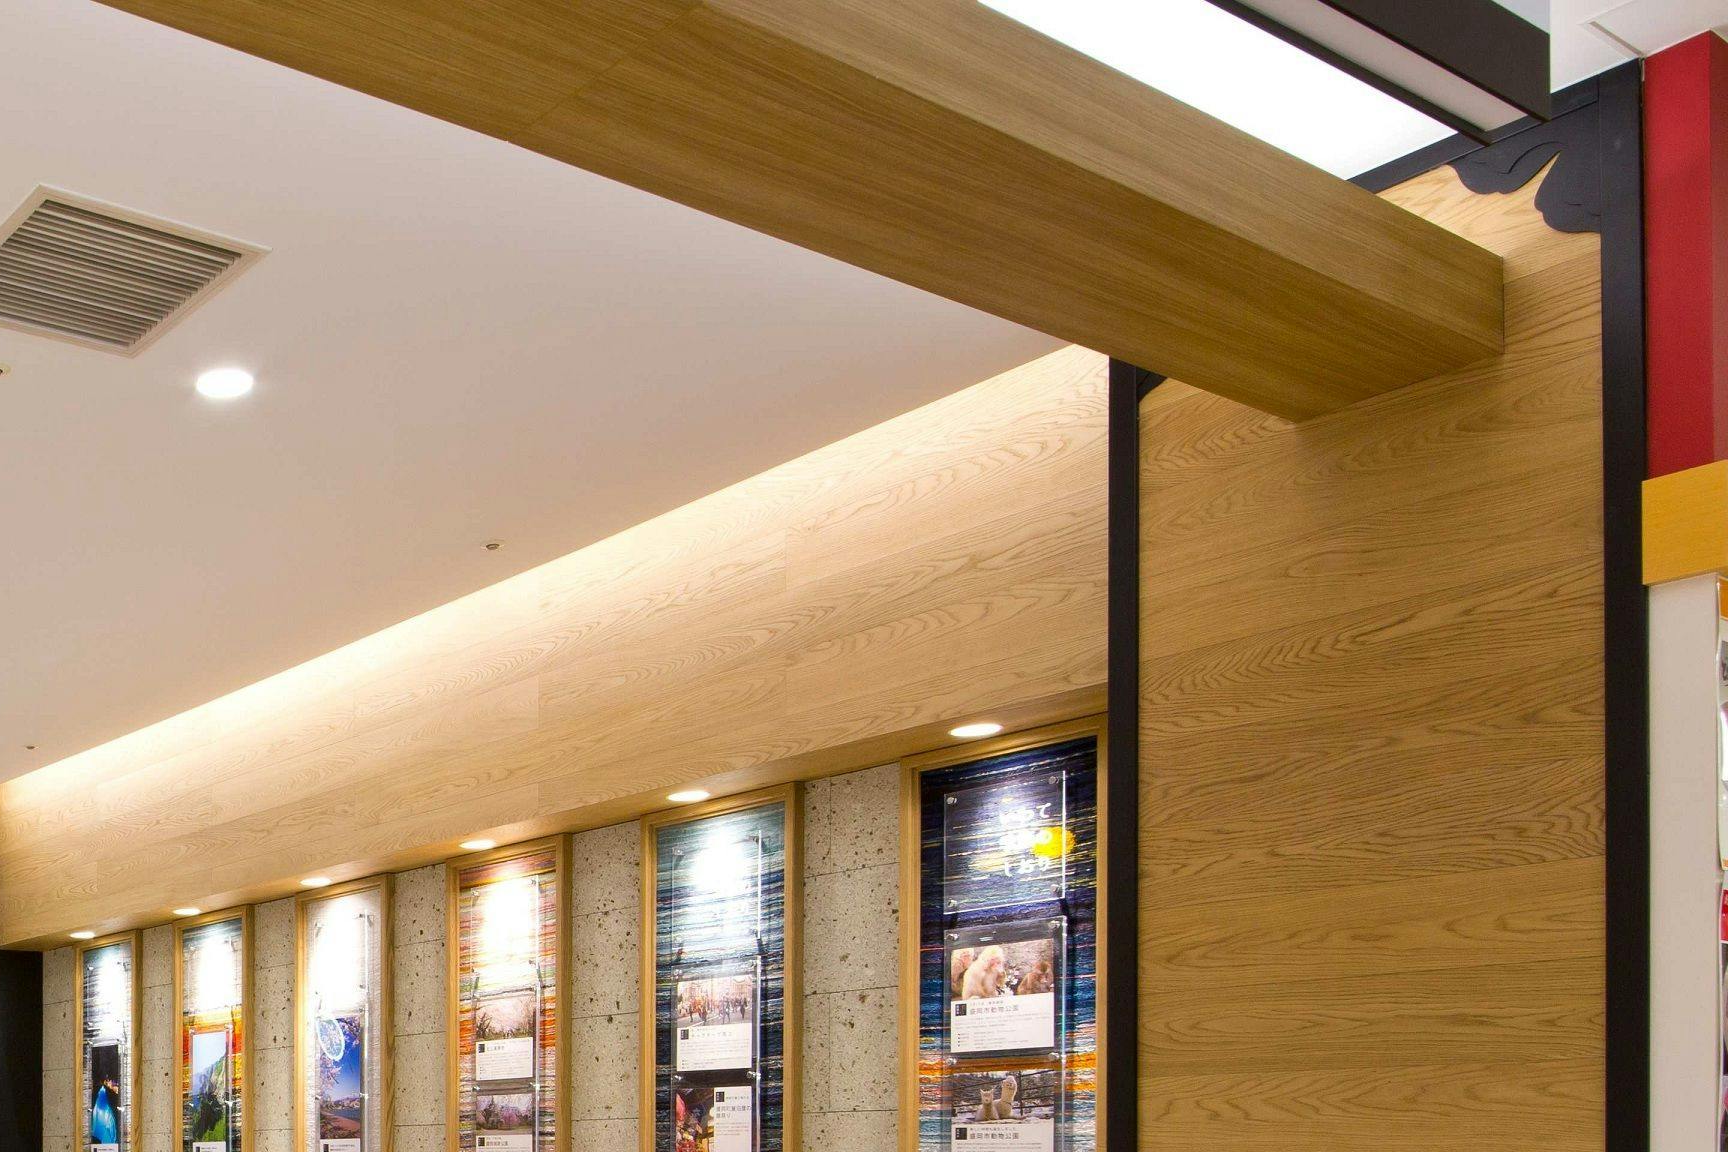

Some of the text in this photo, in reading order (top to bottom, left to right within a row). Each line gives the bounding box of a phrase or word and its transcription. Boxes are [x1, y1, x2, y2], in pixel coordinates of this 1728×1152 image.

[970, 1132, 1019, 1140] 盛岡市動物公園
